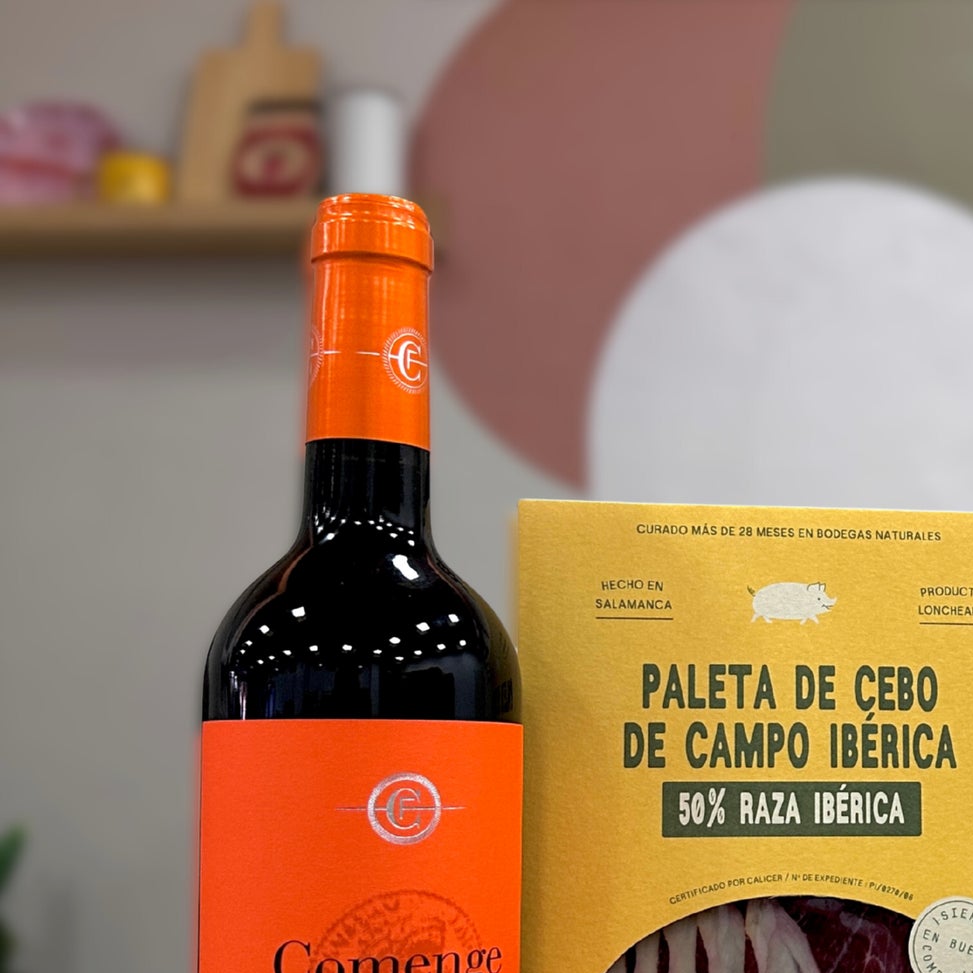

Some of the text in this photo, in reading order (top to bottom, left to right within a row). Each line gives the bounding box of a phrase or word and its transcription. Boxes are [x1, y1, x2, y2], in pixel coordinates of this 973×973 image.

[636, 522, 942, 541] CURADO MÁS DE 28 MESES EN BODEGAS NATURALES
[601, 579, 664, 592] HECHO EN
[595, 598, 673, 611] SALAMANCA
[642, 663, 938, 712] PALETA DE CEBO
[623, 712, 957, 769] DE CAMPO IBÉRICA
[678, 783, 905, 828] 50% RAZA IBÉRICA
[669, 881, 726, 905] CERTIFICADO
[727, 876, 745, 888] POR
[746, 873, 783, 886] CALICER
[802, 873, 813, 882] DE
[922, 928, 940, 944] EN
